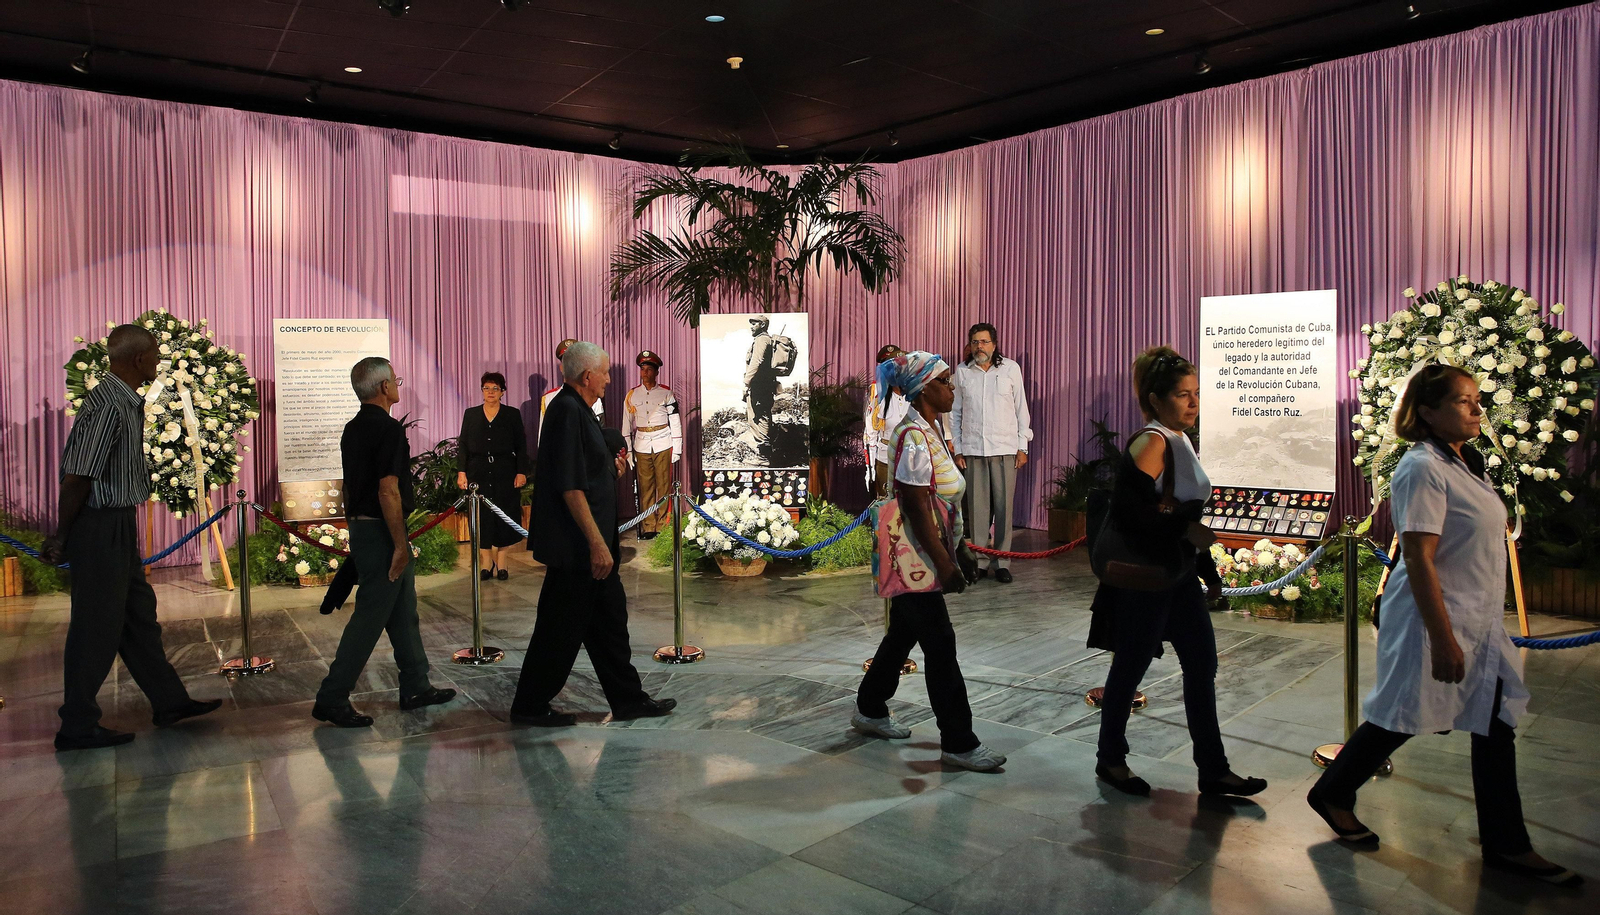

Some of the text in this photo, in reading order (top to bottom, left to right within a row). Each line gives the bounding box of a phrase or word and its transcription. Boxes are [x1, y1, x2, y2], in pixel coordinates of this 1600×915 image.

[1205, 323, 1333, 335] EL Partido Comunista de Cuba,
[1213, 340, 1234, 348] único
[1237, 339, 1272, 348] heredero
[1312, 337, 1324, 346] del
[1225, 352, 1310, 364] legado y la autoridad
[1219, 367, 1230, 375] del
[1233, 366, 1284, 375] Comandante
[1300, 365, 1317, 374] Jefe
[1237, 380, 1282, 388] Revolución
[1285, 380, 1320, 390] Cubana,
[1239, 394, 1295, 404] el compañero
[1232, 408, 1302, 416] Fidel Castro Ruz.
